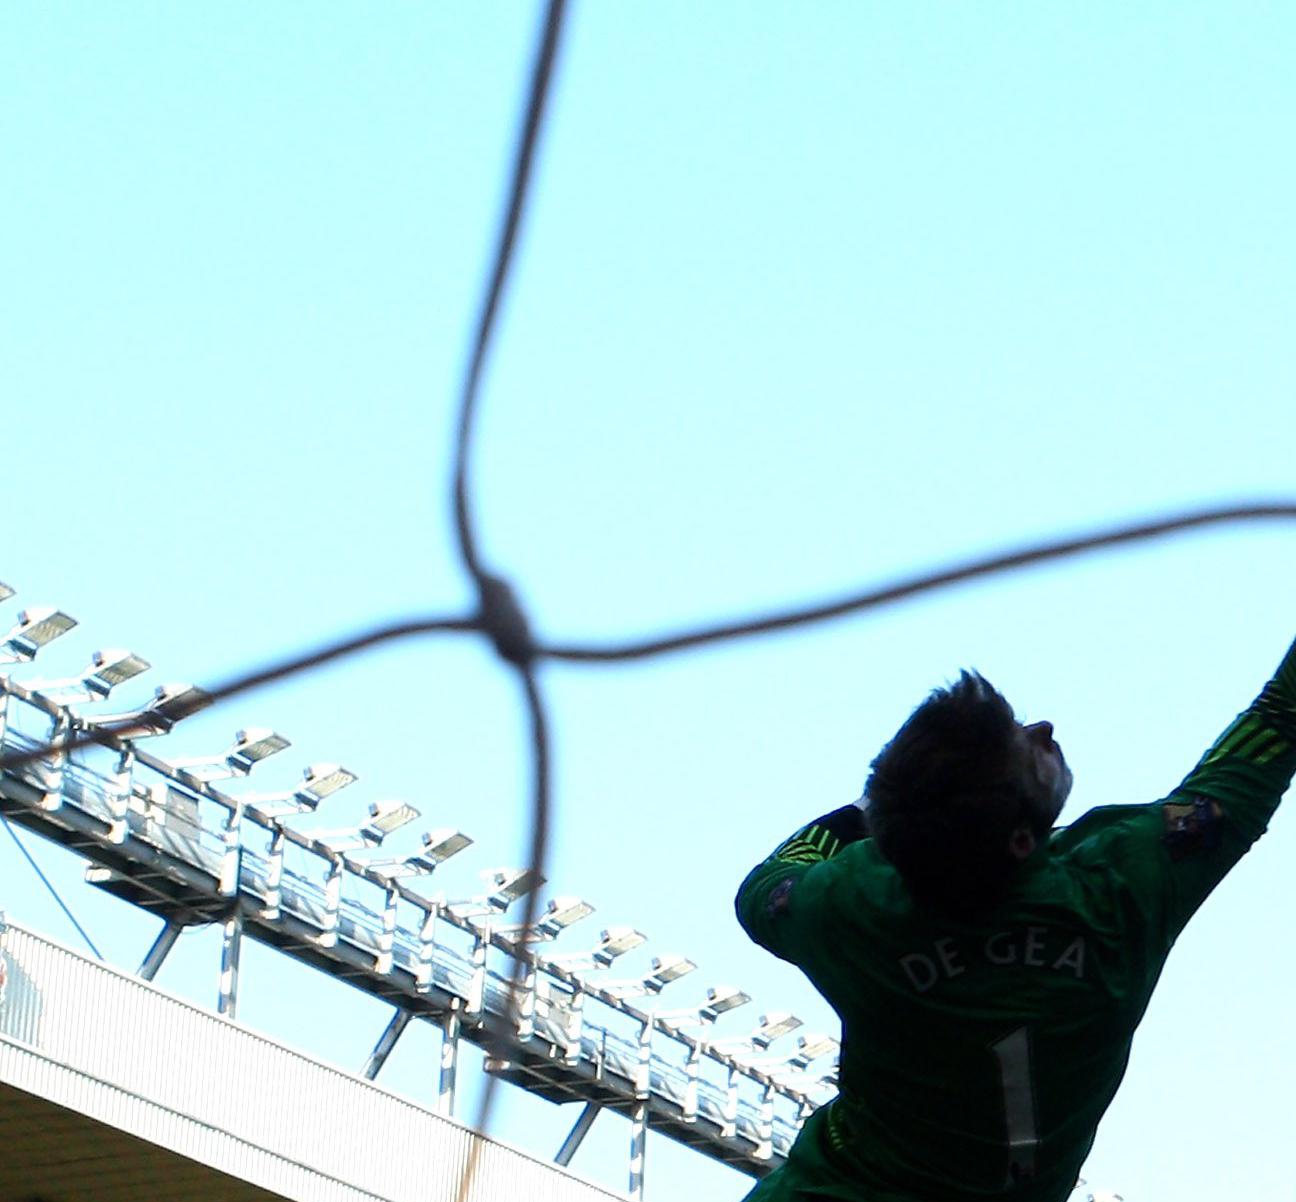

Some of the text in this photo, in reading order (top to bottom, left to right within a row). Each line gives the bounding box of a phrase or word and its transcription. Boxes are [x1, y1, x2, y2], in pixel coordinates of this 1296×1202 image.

[898, 926, 1088, 993] DE GEA
[988, 1023, 1039, 1177] 1
